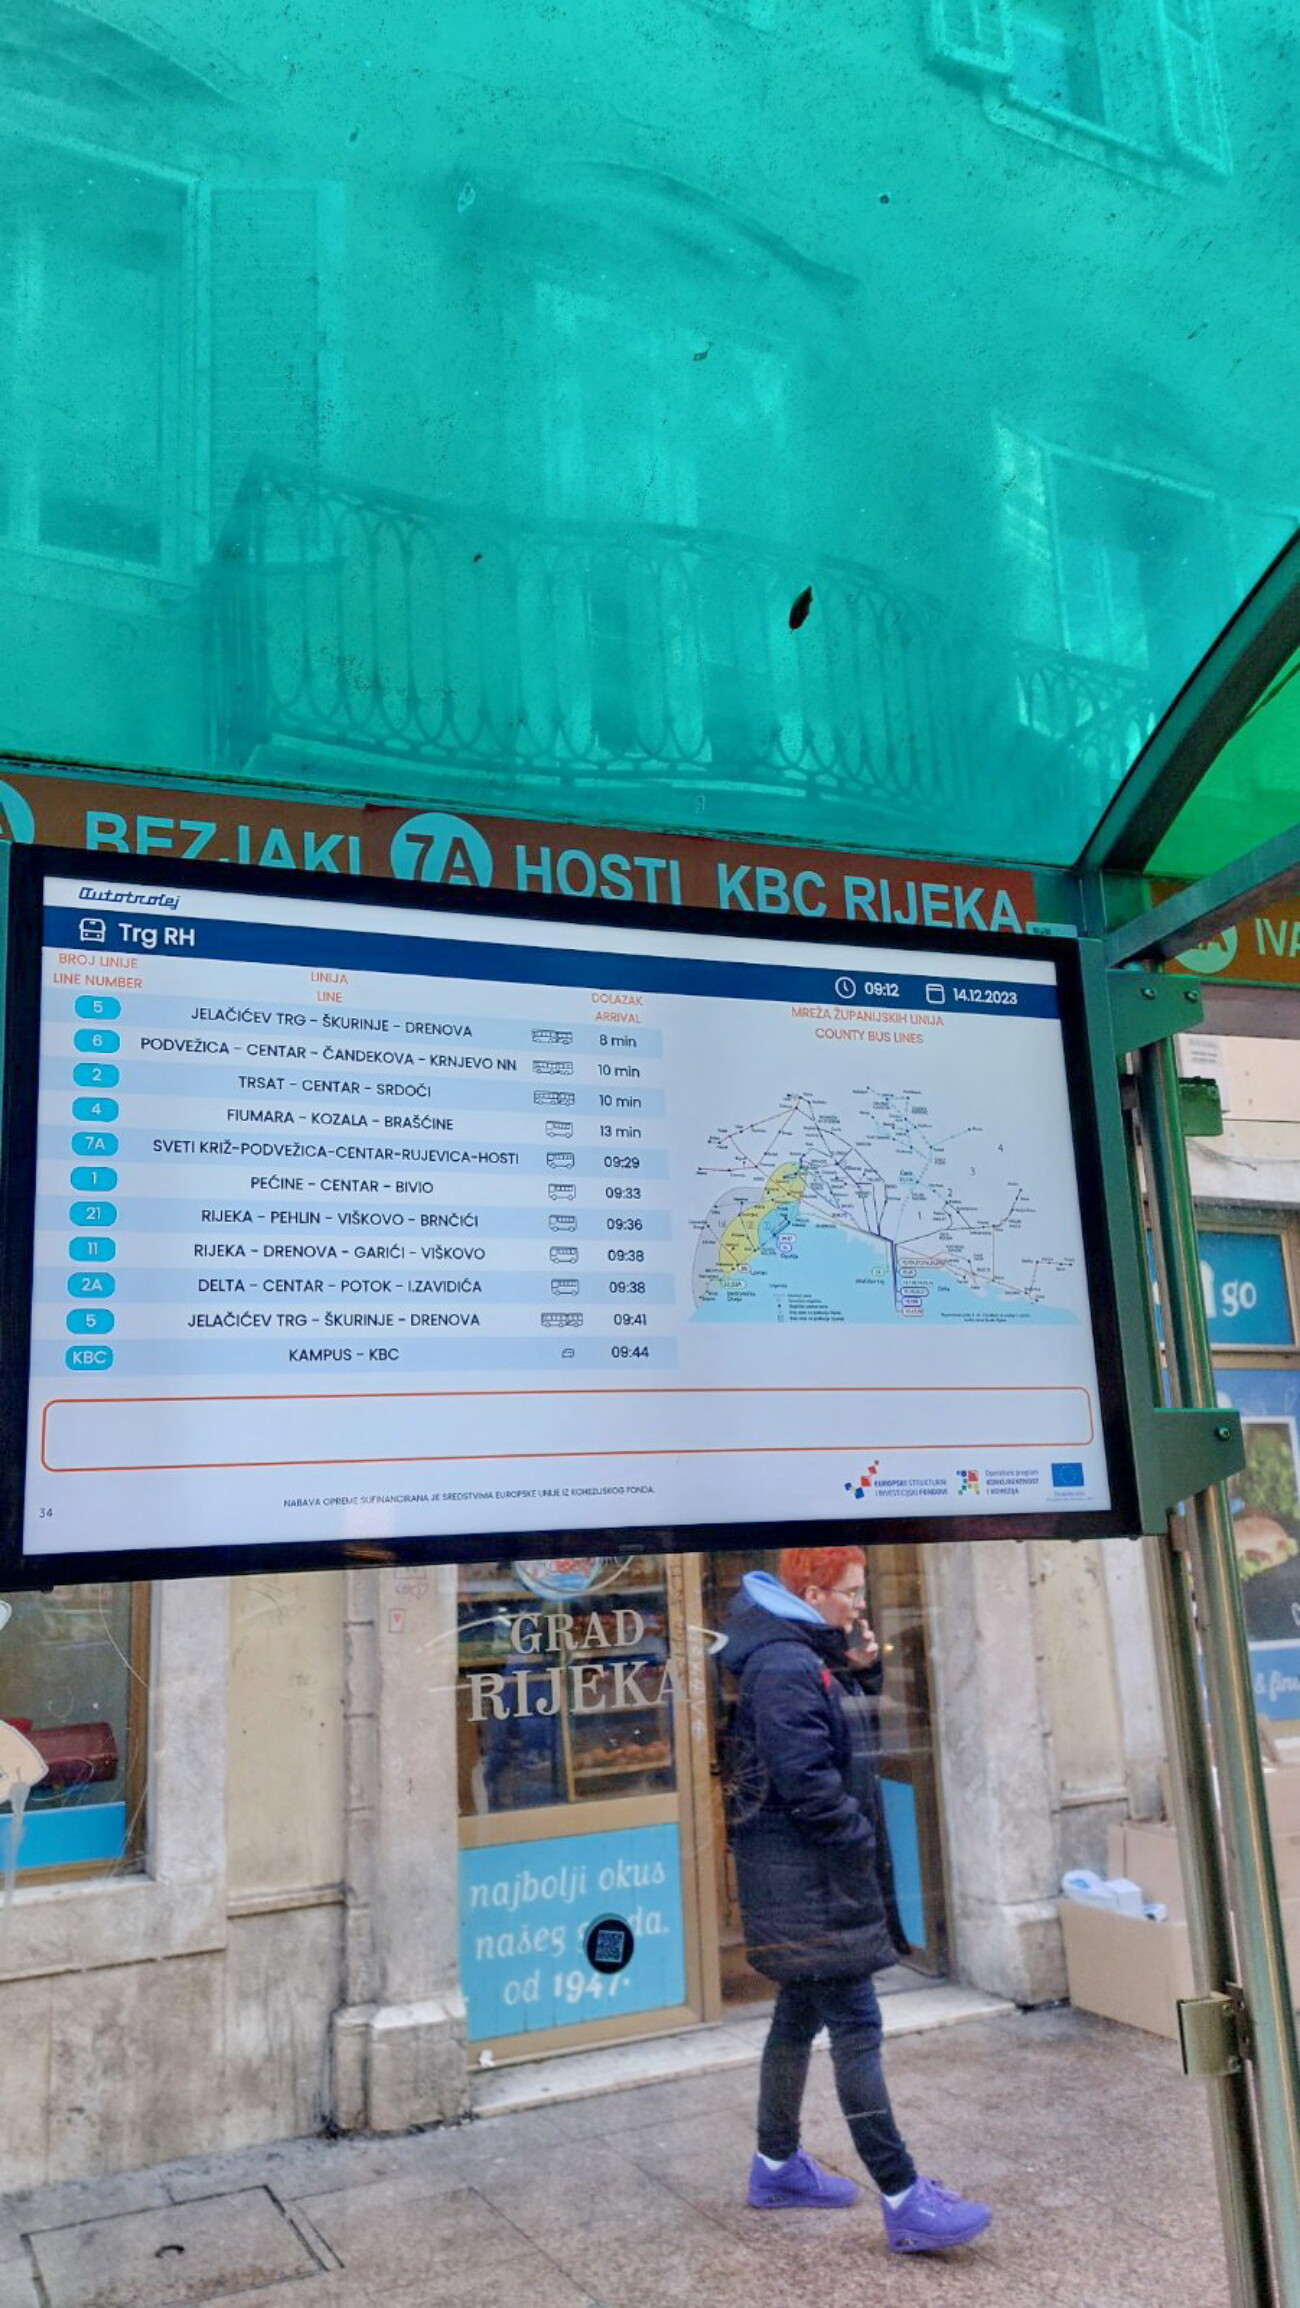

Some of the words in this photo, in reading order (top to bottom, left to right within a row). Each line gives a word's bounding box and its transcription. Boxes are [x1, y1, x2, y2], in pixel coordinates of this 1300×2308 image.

[405, 833, 480, 887] 7A
[516, 845, 682, 905] HOSTI
[717, 863, 827, 917] KBC
[844, 876, 1026, 935] RIJEKA
[118, 923, 158, 949] Trg
[164, 927, 196, 947] RH
[58, 953, 95, 967] BROJ
[99, 956, 139, 969] LINIJE
[53, 972, 82, 985] LINE
[85, 975, 144, 989] NUMBER
[310, 971, 348, 985] LINIJA
[316, 991, 343, 1003] LINE
[591, 992, 644, 1006] DOLAZAK
[864, 982, 900, 997] 09:12
[953, 987, 1018, 1005] 14.12.2023
[92, 999, 104, 1013] 5
[191, 1006, 272, 1024] JELAČIĆEV
[276, 1011, 306, 1027] TRG
[322, 1011, 389, 1032] ŠKURINJE
[405, 1021, 473, 1037] DRENOVA
[595, 1011, 641, 1024] ARRIVAL
[791, 1004, 832, 1020] MREŽA
[833, 1006, 907, 1024] ŽUPANIJSKIH
[910, 1013, 944, 1027] LINIJA
[92, 1034, 103, 1047] 6
[599, 1034, 607, 1046] 8
[611, 1034, 637, 1048] min
[815, 1027, 865, 1041] COUNTY
[868, 1029, 891, 1043] BUS
[894, 1031, 924, 1044] LINES
[140, 1036, 230, 1054] PODVEŽICA
[246, 1043, 307, 1059] CENTAR
[322, 1045, 414, 1066] ČANDEKOVA
[430, 1054, 493, 1070] KRNJEVO
[497, 1058, 517, 1071] NN
[92, 1068, 102, 1082] 2
[598, 1063, 611, 1077] 10
[614, 1064, 640, 1078] min
[238, 1075, 285, 1090] TRSAT
[302, 1079, 360, 1094] CENTAR
[376, 1081, 431, 1097] SRDOČI
[599, 1094, 612, 1107] 10
[615, 1094, 641, 1108] min
[91, 1103, 102, 1115] 4
[227, 1109, 294, 1124] FIUMARA
[311, 1112, 368, 1127] KOZALA
[384, 1113, 454, 1131] BRAŠĆINE
[599, 1125, 612, 1138] 13
[615, 1125, 641, 1139] min
[84, 1136, 106, 1150] 7A
[153, 1139, 195, 1154] SVETI
[603, 1156, 640, 1169] 09:29
[91, 1171, 97, 1184] 1
[250, 1174, 304, 1191] PEĆINE
[320, 1177, 379, 1192] CENTAR
[395, 1181, 434, 1194] BIVIO
[605, 1187, 641, 1200] 09:33
[85, 1206, 100, 1220] 21
[201, 1209, 253, 1224] RIJEKA
[270, 1210, 321, 1225] PEHLIN
[337, 1211, 404, 1226] VIŠKOVO
[420, 1211, 479, 1228] BRNČIĆI
[606, 1218, 643, 1231] 09:36
[87, 1241, 98, 1255] 11
[194, 1244, 246, 1258] RIJEKA
[263, 1245, 337, 1259] DRENOVA
[354, 1243, 404, 1259] GARIĆI
[421, 1244, 486, 1260] VIŠKOVO
[607, 1249, 645, 1263] 09:38
[81, 1278, 103, 1291] 2A
[198, 1279, 246, 1293] DELTA
[262, 1279, 324, 1293] CENTAR
[341, 1279, 391, 1293] POTOK
[608, 1281, 646, 1294] 09:38
[1221, 1280, 1258, 1317] go
[85, 1314, 97, 1327] 5
[187, 1311, 272, 1328] JELAČIĆEV
[276, 1314, 307, 1327] TRG
[324, 1309, 394, 1327] ŠKURINJE
[410, 1313, 480, 1327] DRENOVA
[613, 1313, 647, 1326] 09:41
[72, 1351, 107, 1364] KBC
[289, 1348, 352, 1362] KAMPUS
[368, 1348, 400, 1361] KBC
[611, 1346, 649, 1359] 09:44
[283, 1497, 322, 1508] NABAVA
[495, 1489, 537, 1500] EUROPSKE
[38, 1507, 53, 1518] 34
[510, 1609, 645, 1654] GRAD
[466, 1658, 688, 1722] RIJEKA
[470, 1865, 587, 1913] najbolji
[599, 1859, 666, 1892] okus
[475, 1923, 566, 1961] našeg
[504, 1970, 541, 2005] od
